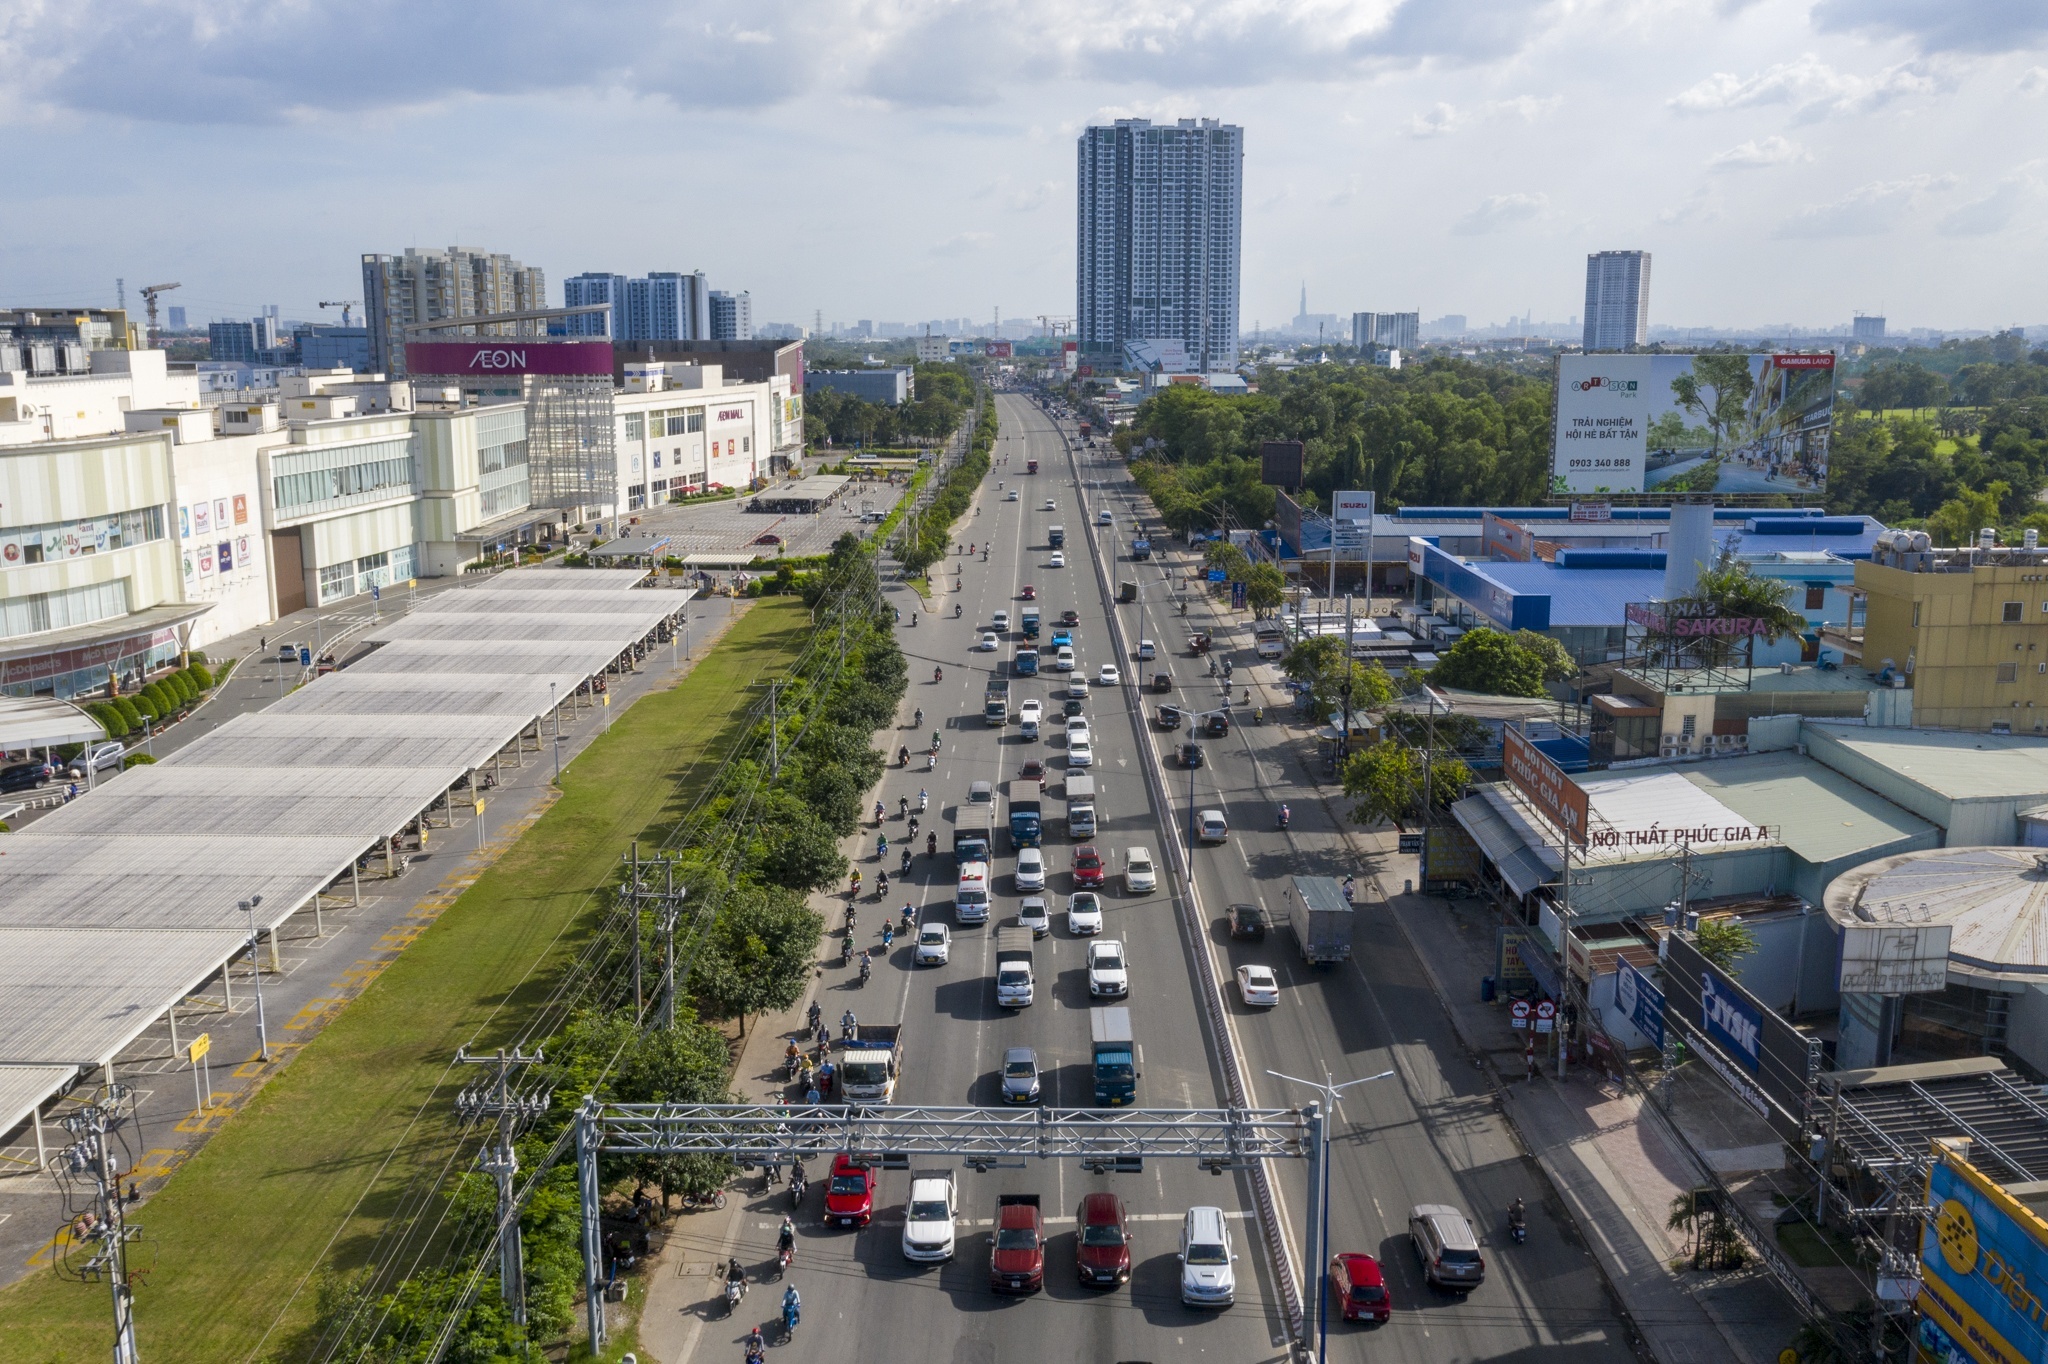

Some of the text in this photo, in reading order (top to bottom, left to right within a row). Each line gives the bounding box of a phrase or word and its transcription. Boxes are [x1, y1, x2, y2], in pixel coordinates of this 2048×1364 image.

[1572, 377, 1637, 390] ARTISAN
[1573, 416, 1633, 428] TRẢI NGHIỆM
[1565, 428, 1638, 440] HỘI HÈ BẤT TẬN
[1569, 459, 1631, 467] 0903 340 888
[1675, 618, 1767, 636] SAKURA
[1512, 754, 1578, 827] PHÚC GIA AN
[1593, 821, 1768, 850] NỘI THẤT PHÚC GIA A
[1711, 994, 1758, 1057] JYSK
